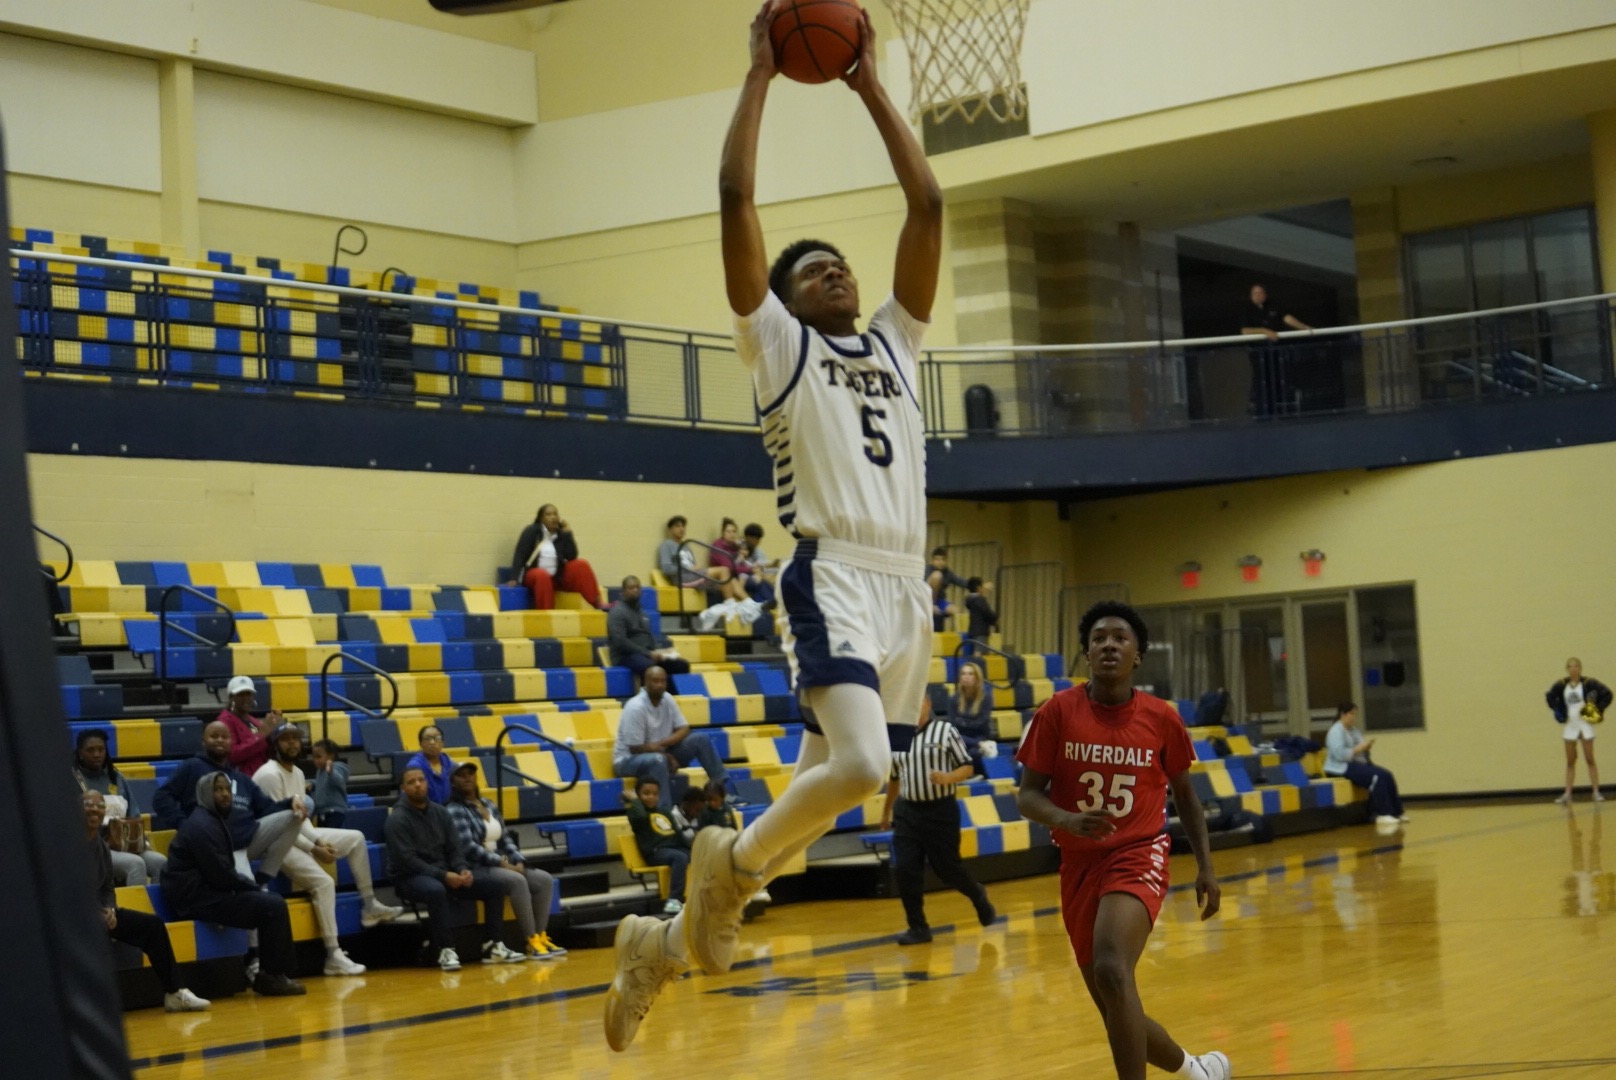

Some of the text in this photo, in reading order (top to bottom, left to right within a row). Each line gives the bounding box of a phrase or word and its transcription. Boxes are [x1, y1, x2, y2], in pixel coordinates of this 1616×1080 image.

[862, 405, 893, 467] 5
[1065, 742, 1153, 766] RIVERDALE
[1077, 771, 1135, 818] 35
